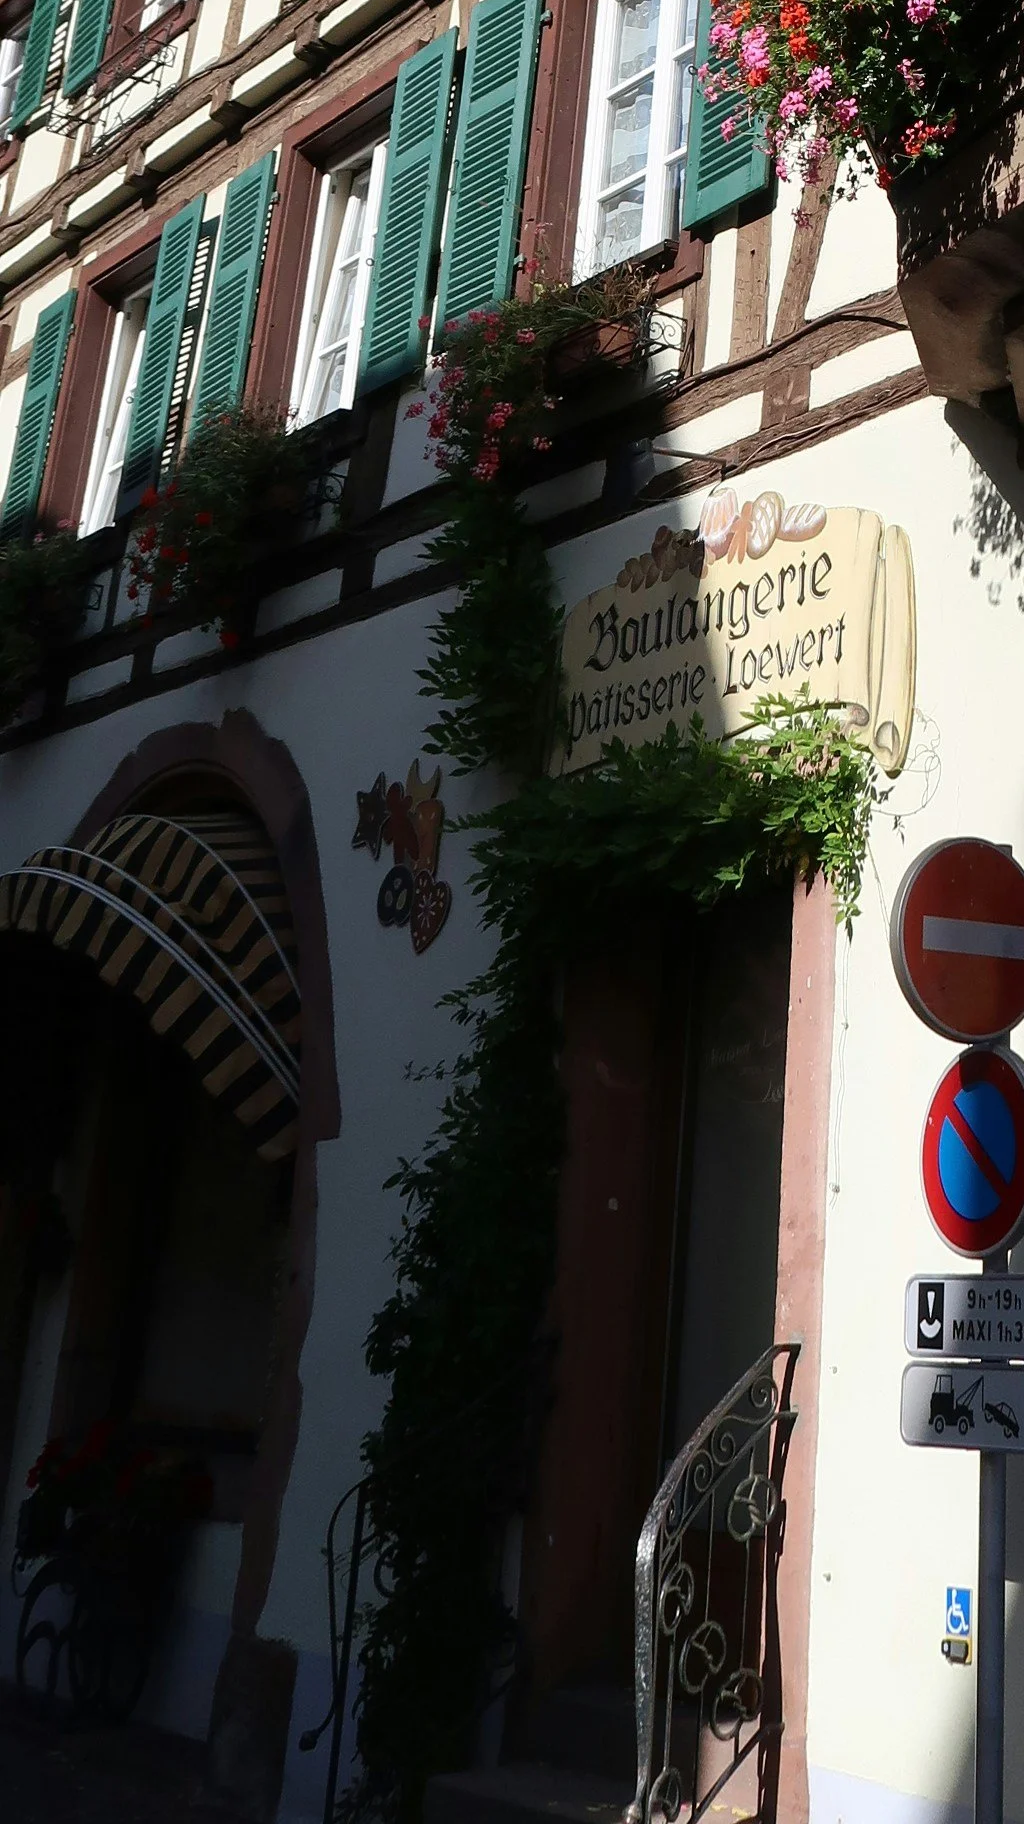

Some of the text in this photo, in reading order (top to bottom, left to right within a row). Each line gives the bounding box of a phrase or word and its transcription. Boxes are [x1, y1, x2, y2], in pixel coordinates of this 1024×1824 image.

[583, 550, 833, 672] Boulangerie
[722, 612, 846, 698] Loewert
[967, 1288, 1022, 1310] 9h-19h
[952, 1319, 992, 1342] MAXI
